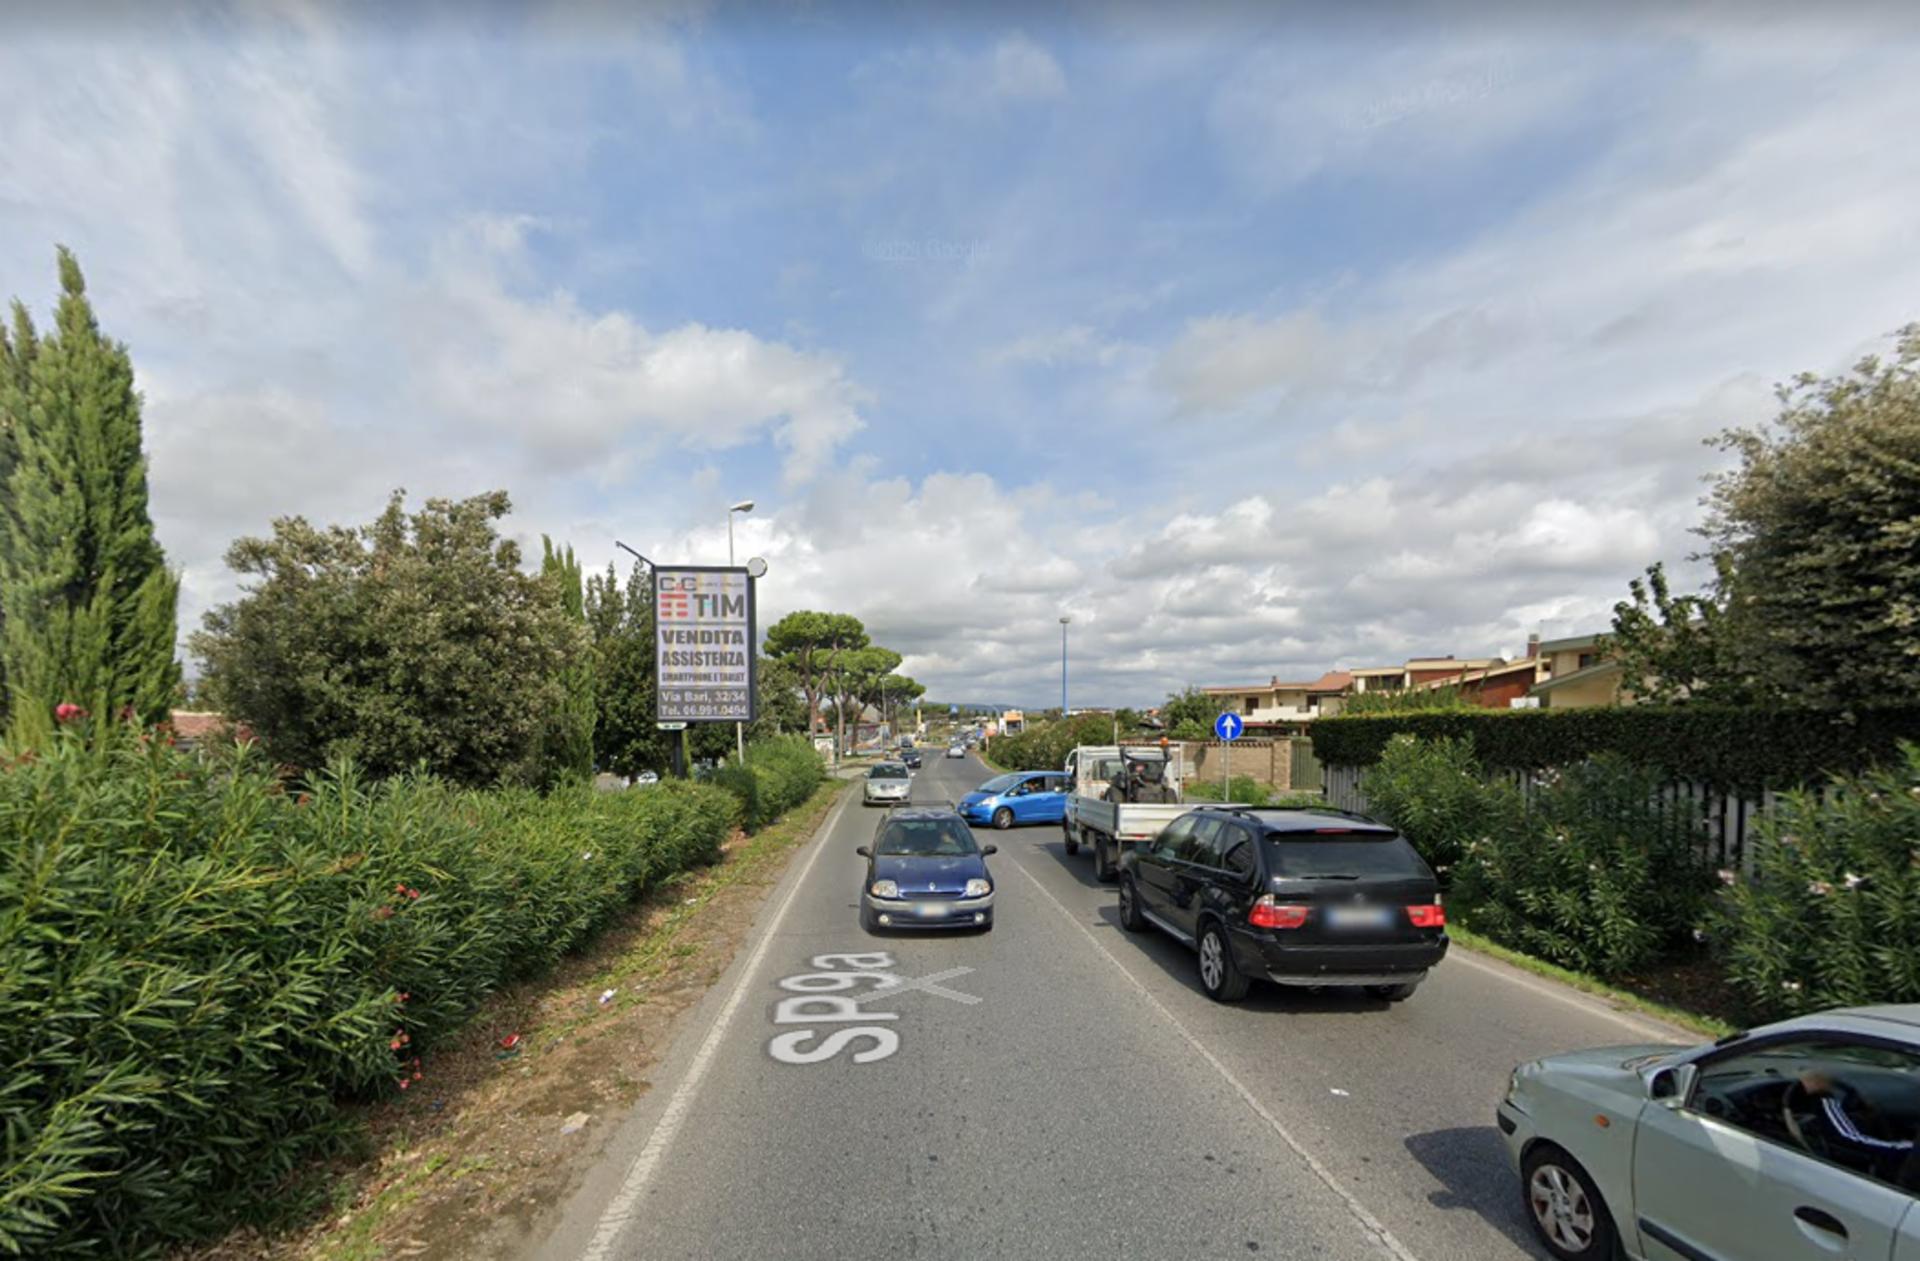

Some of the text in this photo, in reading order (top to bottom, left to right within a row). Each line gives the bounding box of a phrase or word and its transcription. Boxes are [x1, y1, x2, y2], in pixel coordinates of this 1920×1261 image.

[693, 593, 744, 618] TIM
[661, 630, 744, 645] VENDITA
[661, 651, 745, 666] ASSISTENZA
[661, 691, 681, 702] Via
[684, 691, 712, 704] Bari,
[661, 705, 680, 716] Tel.
